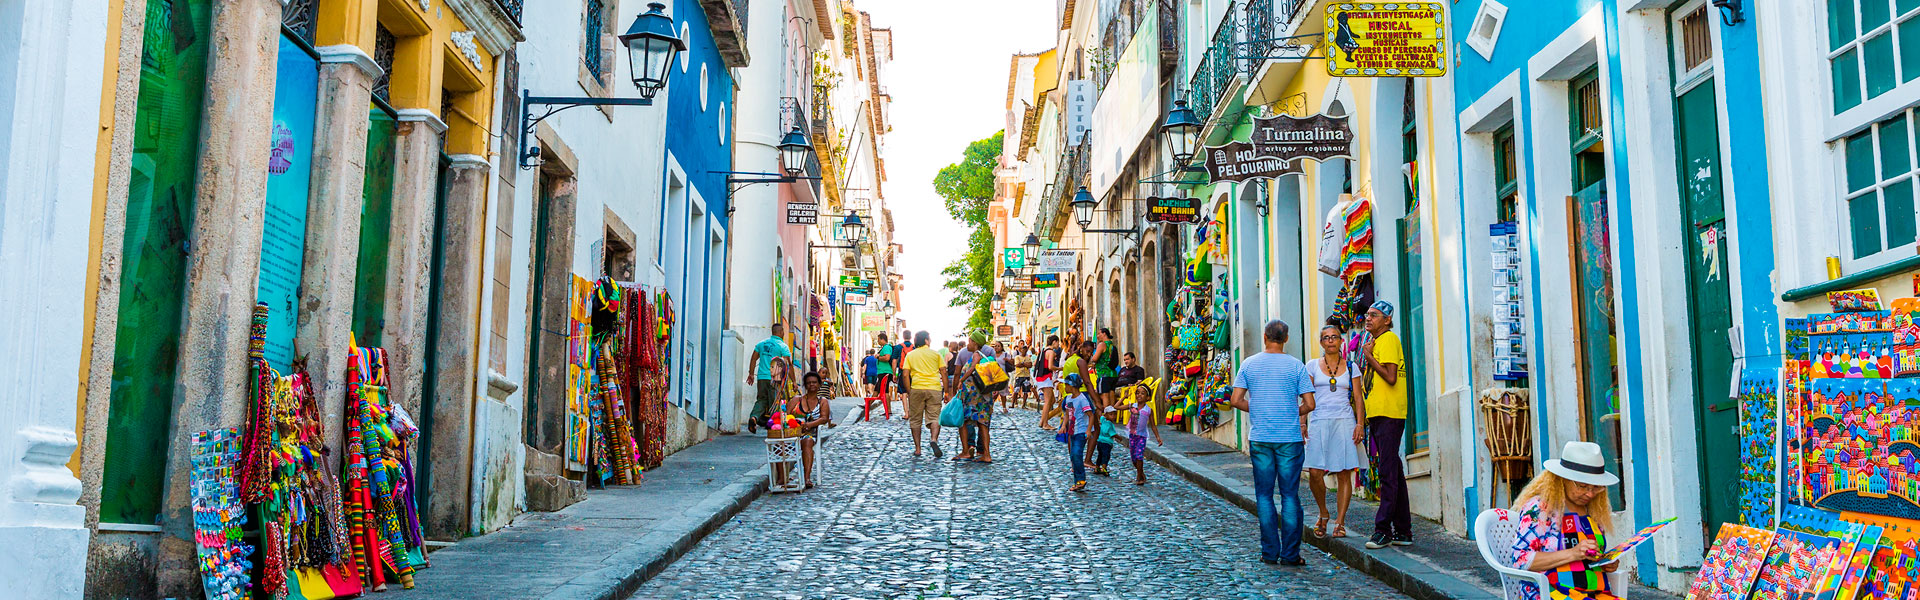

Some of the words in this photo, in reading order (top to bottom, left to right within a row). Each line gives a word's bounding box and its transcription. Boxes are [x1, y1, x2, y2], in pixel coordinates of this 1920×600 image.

[1382, 8, 1434, 19] INVESTIGAÇÃO
[1369, 21, 1412, 30] MUSICAL
[1393, 45, 1436, 53] PERCUSSÃO
[1076, 84, 1085, 142] TATTOO
[1262, 127, 1344, 141] Turmalina
[1265, 145, 1296, 153] artigos
[1305, 145, 1345, 153] regionais
[1218, 160, 1290, 177] PELOURINHO
[1171, 207, 1195, 215] BAHIA
